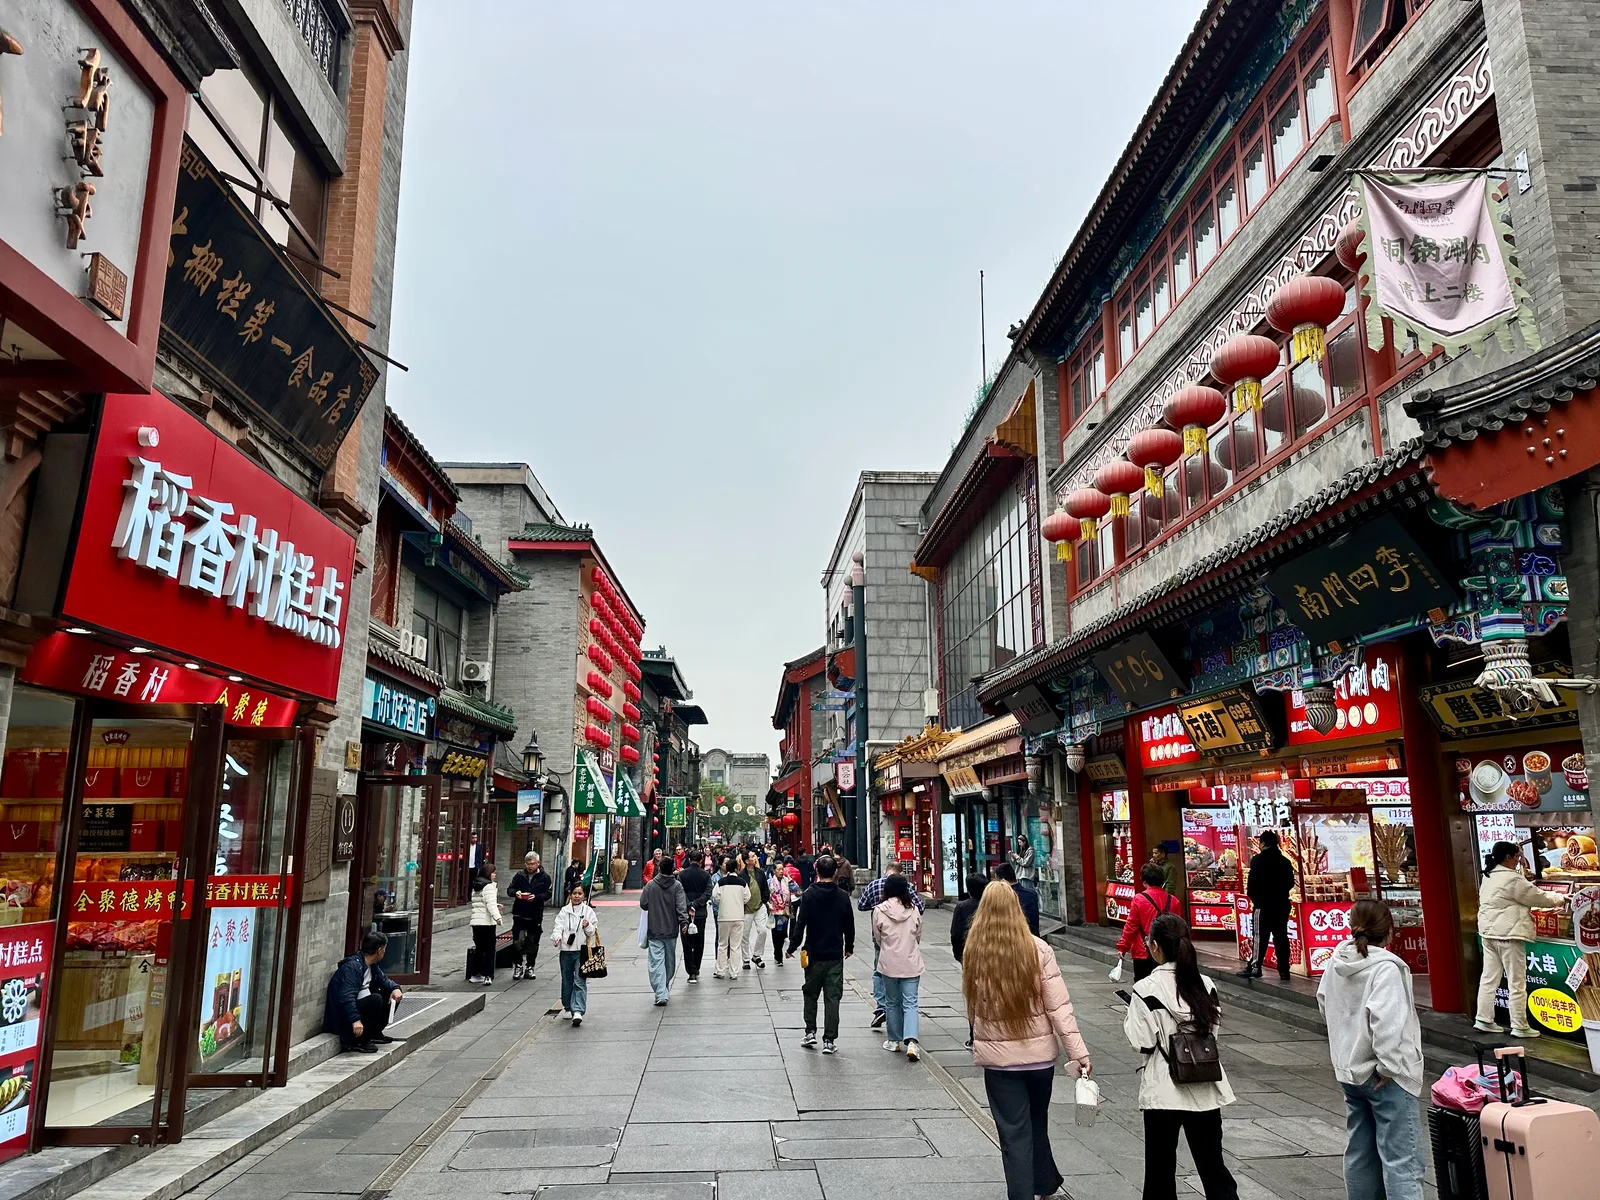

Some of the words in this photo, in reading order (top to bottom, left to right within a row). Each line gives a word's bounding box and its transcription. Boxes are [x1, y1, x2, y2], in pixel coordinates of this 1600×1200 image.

[1380, 234, 1491, 266] 铜锅涮肉
[1399, 281, 1484, 303] 请上二楼
[112, 456, 344, 649] 稻香村糕点
[82, 655, 169, 702] 稻香村
[375, 684, 428, 735] 你好酒店
[1229, 702, 1252, 720] 69号
[1229, 796, 1290, 827] 冰糖葫芦
[1478, 816, 1513, 827] 老北京
[1479, 830, 1515, 842] 爆肚粉
[74, 889, 186, 913] 全聚德烤鸭
[1313, 912, 1350, 927] 冰糖
[210, 916, 249, 949] 全聚德
[1532, 995, 1577, 1014] 100%纯羊肉
[1540, 1010, 1573, 1028] 假一罚百
